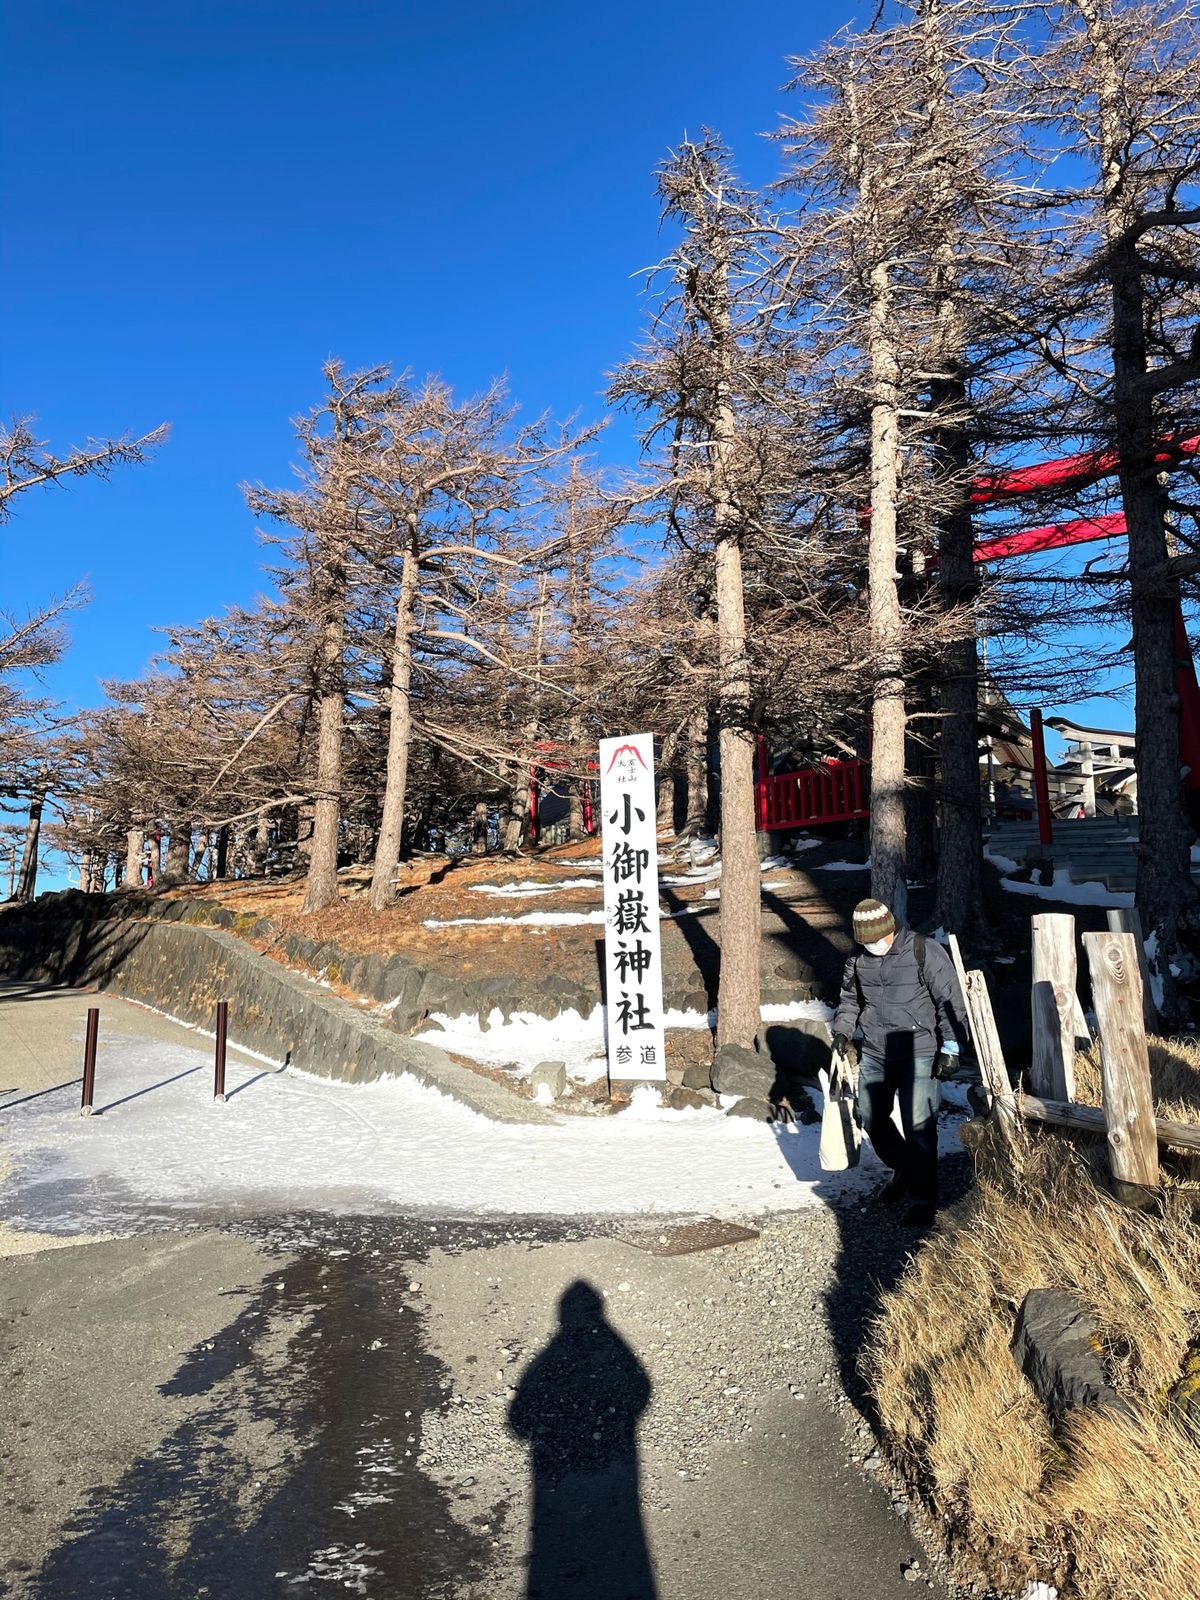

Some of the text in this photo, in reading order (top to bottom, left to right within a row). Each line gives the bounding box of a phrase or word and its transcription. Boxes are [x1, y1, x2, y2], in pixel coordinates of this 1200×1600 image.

[609, 793, 655, 1036] 小御嶽神社
[616, 1045, 657, 1064] 参道
